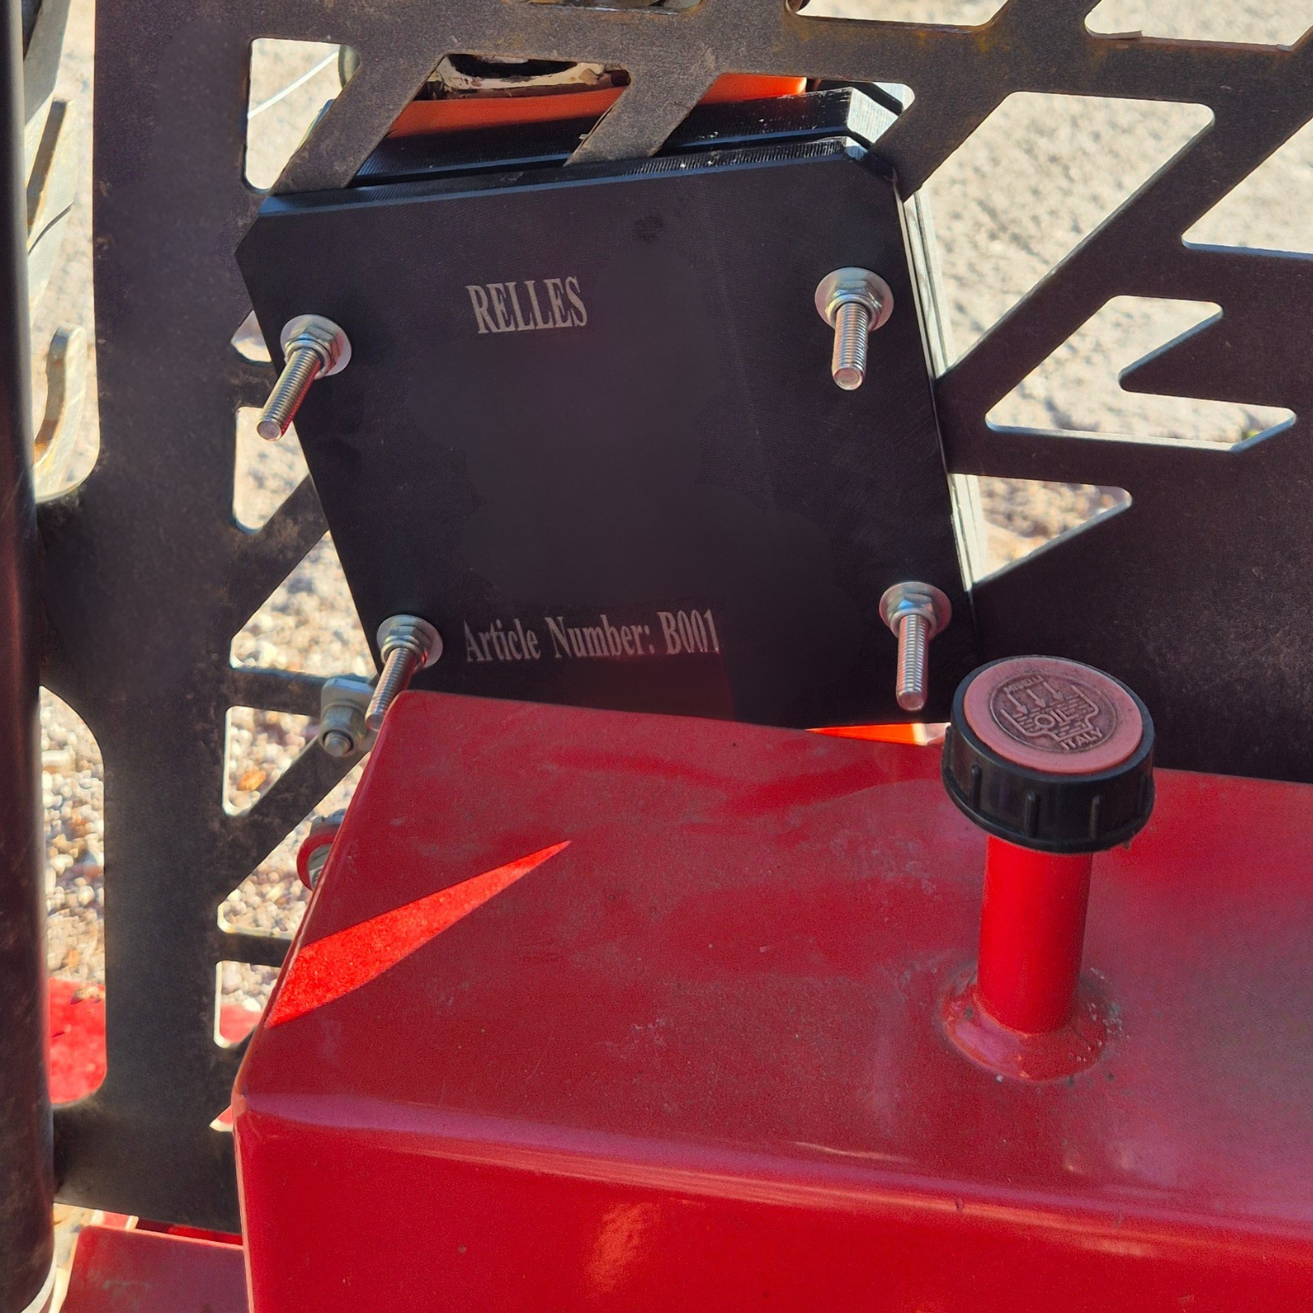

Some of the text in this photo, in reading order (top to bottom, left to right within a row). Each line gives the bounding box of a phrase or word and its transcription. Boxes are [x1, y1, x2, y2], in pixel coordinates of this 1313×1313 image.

[465, 276, 588, 334] RELLES
[463, 608, 720, 662] Article Number: B001
[1033, 708, 1080, 729] OIL
[1059, 727, 1103, 750] ITALY
